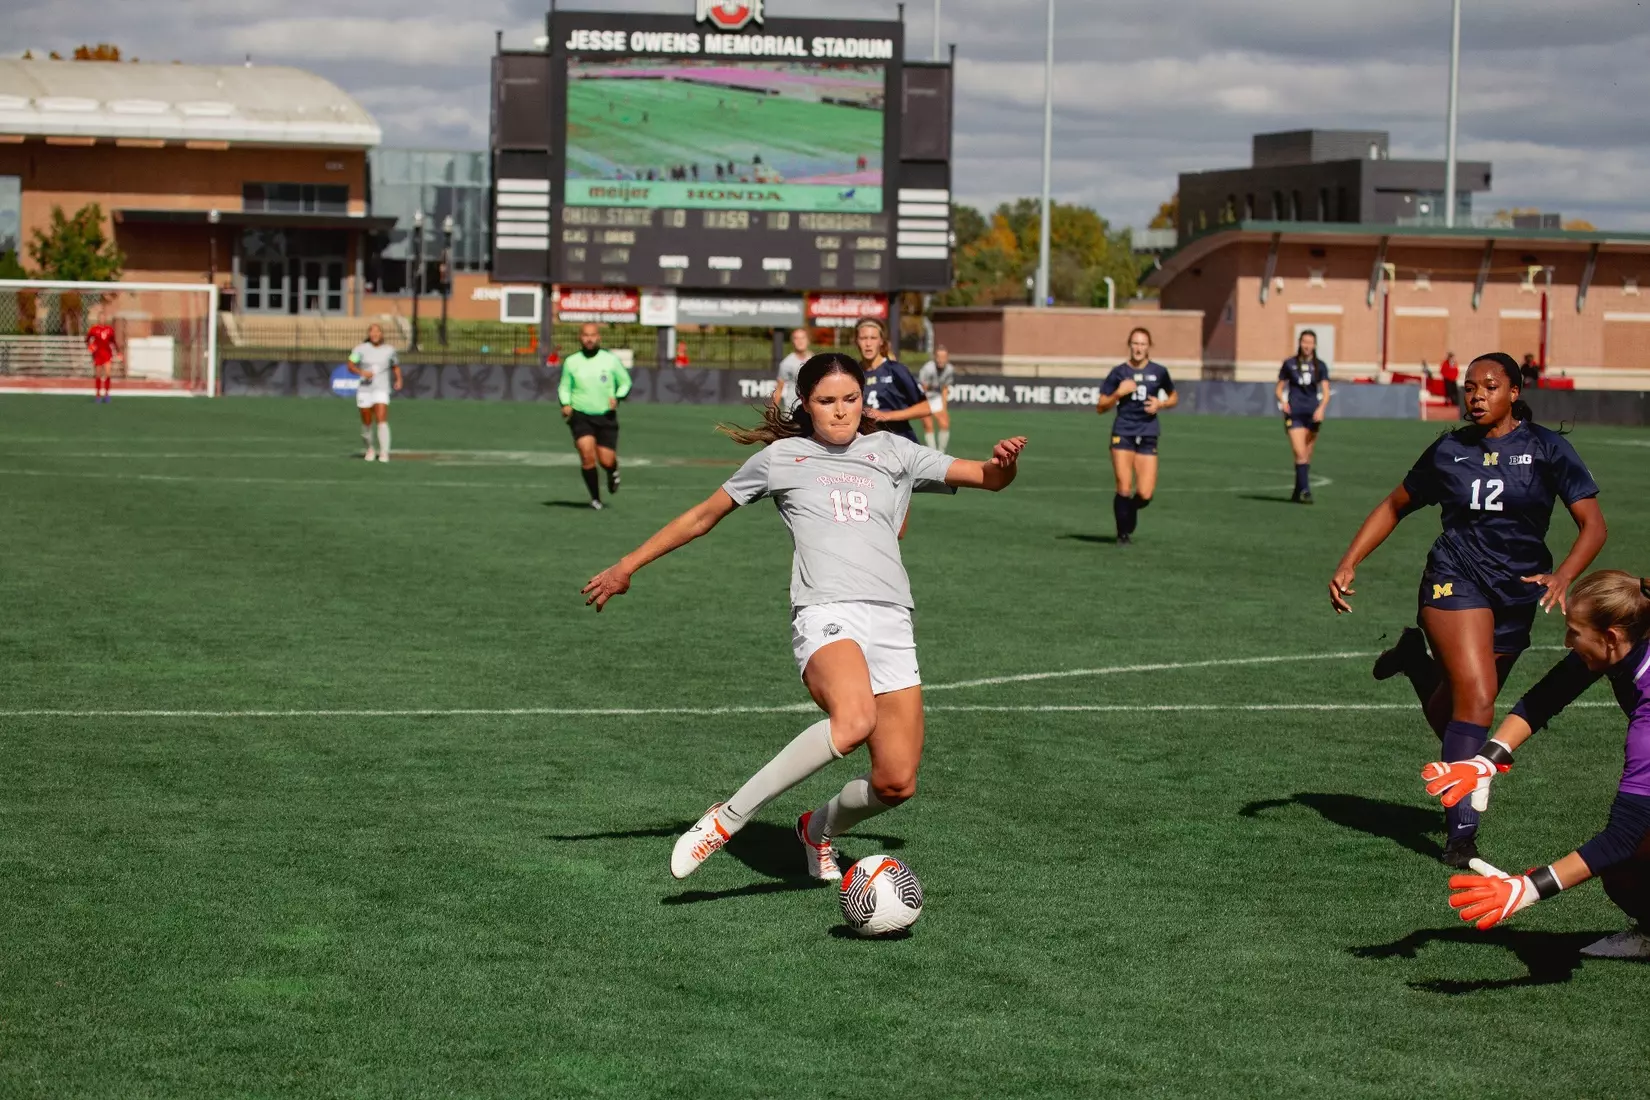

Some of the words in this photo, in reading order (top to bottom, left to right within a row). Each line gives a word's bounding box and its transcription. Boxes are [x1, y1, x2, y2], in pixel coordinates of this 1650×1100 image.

[565, 29, 627, 51] JESSE
[630, 31, 700, 54] OWENS
[704, 33, 808, 57] MEMORIAL
[812, 36, 893, 59] STADIUM
[588, 181, 650, 202] meijer
[687, 188, 784, 201] HONDA
[738, 379, 777, 398] THE
[947, 384, 1010, 403] DITION.
[1013, 385, 1050, 403] THE
[1054, 386, 1100, 405] EXCE
[867, 390, 880, 409] 4
[1483, 452, 1499, 466] M
[1470, 478, 1504, 511] 12
[830, 489, 870, 523] 18
[1433, 583, 1453, 599] M
